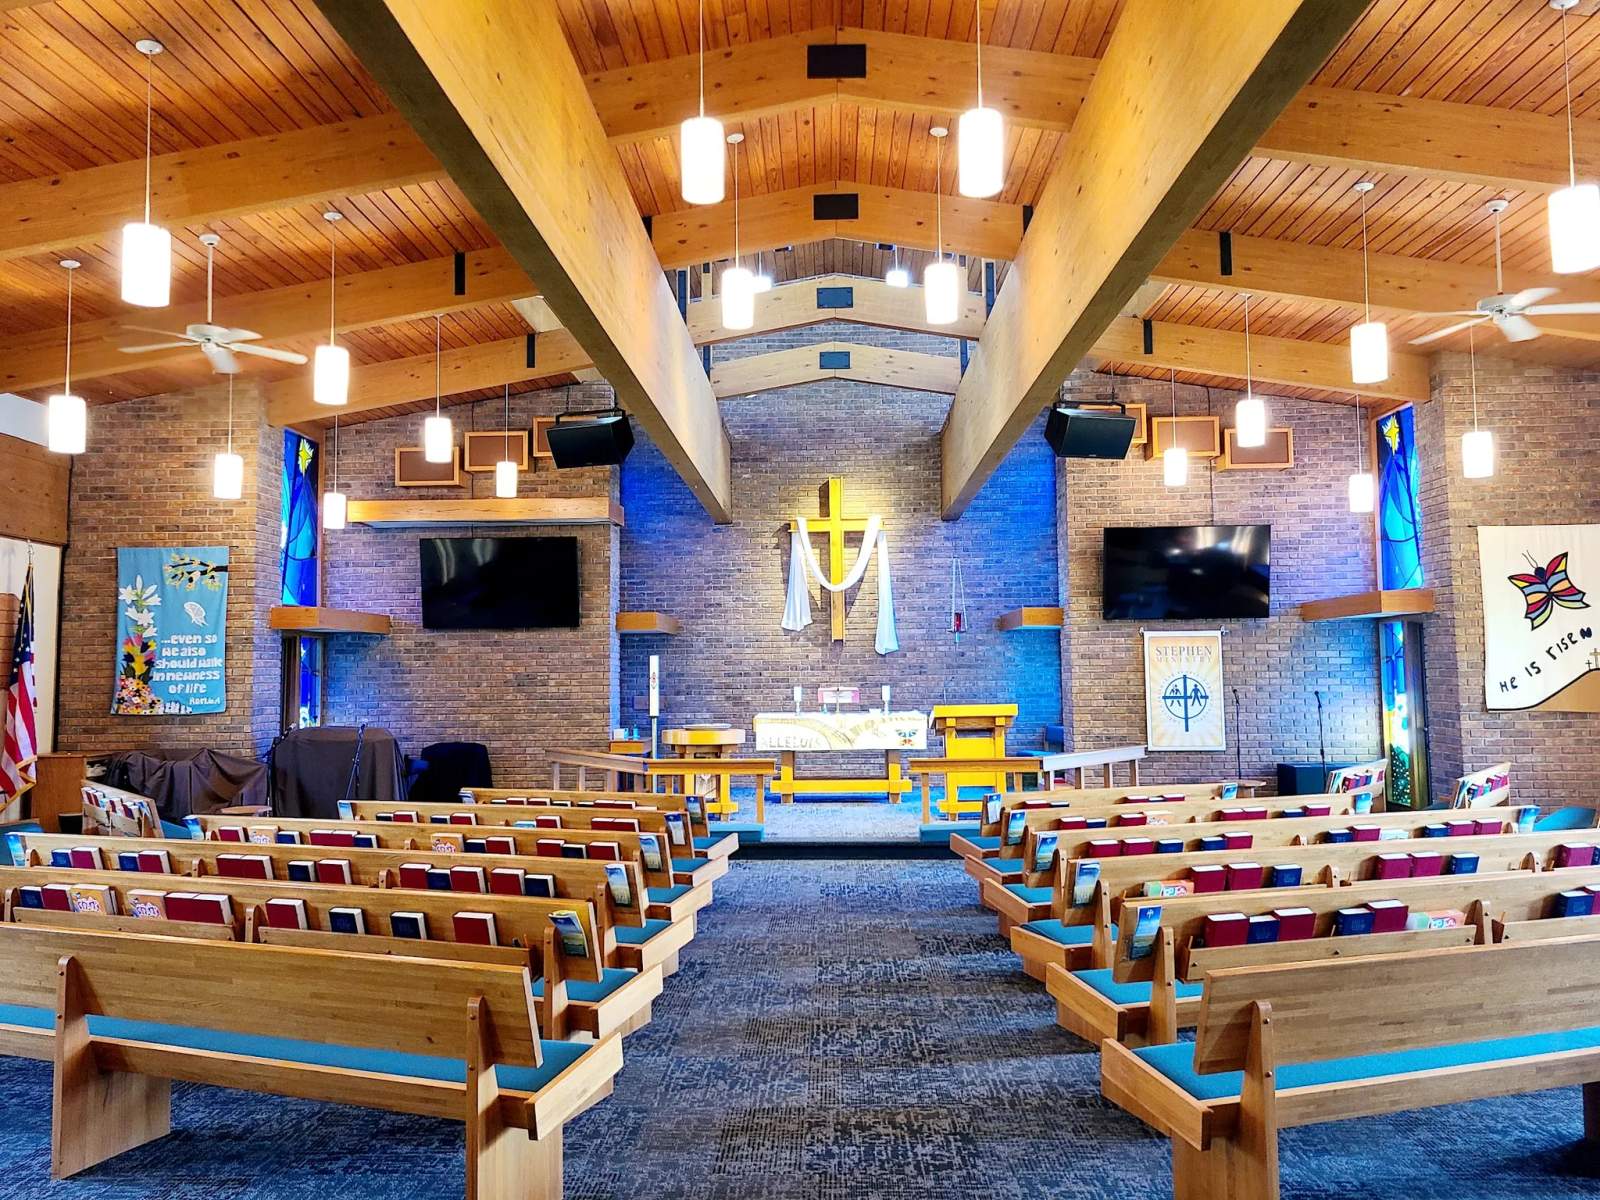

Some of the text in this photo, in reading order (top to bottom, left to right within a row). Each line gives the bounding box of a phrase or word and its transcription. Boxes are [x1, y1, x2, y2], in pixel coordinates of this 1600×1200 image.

[205, 634, 218, 644] so
[162, 647, 207, 657] we also
[1155, 646, 1212, 656] STEPHEN
[154, 658, 196, 669] should
[166, 670, 220, 681] newness
[169, 683, 207, 694] of life
